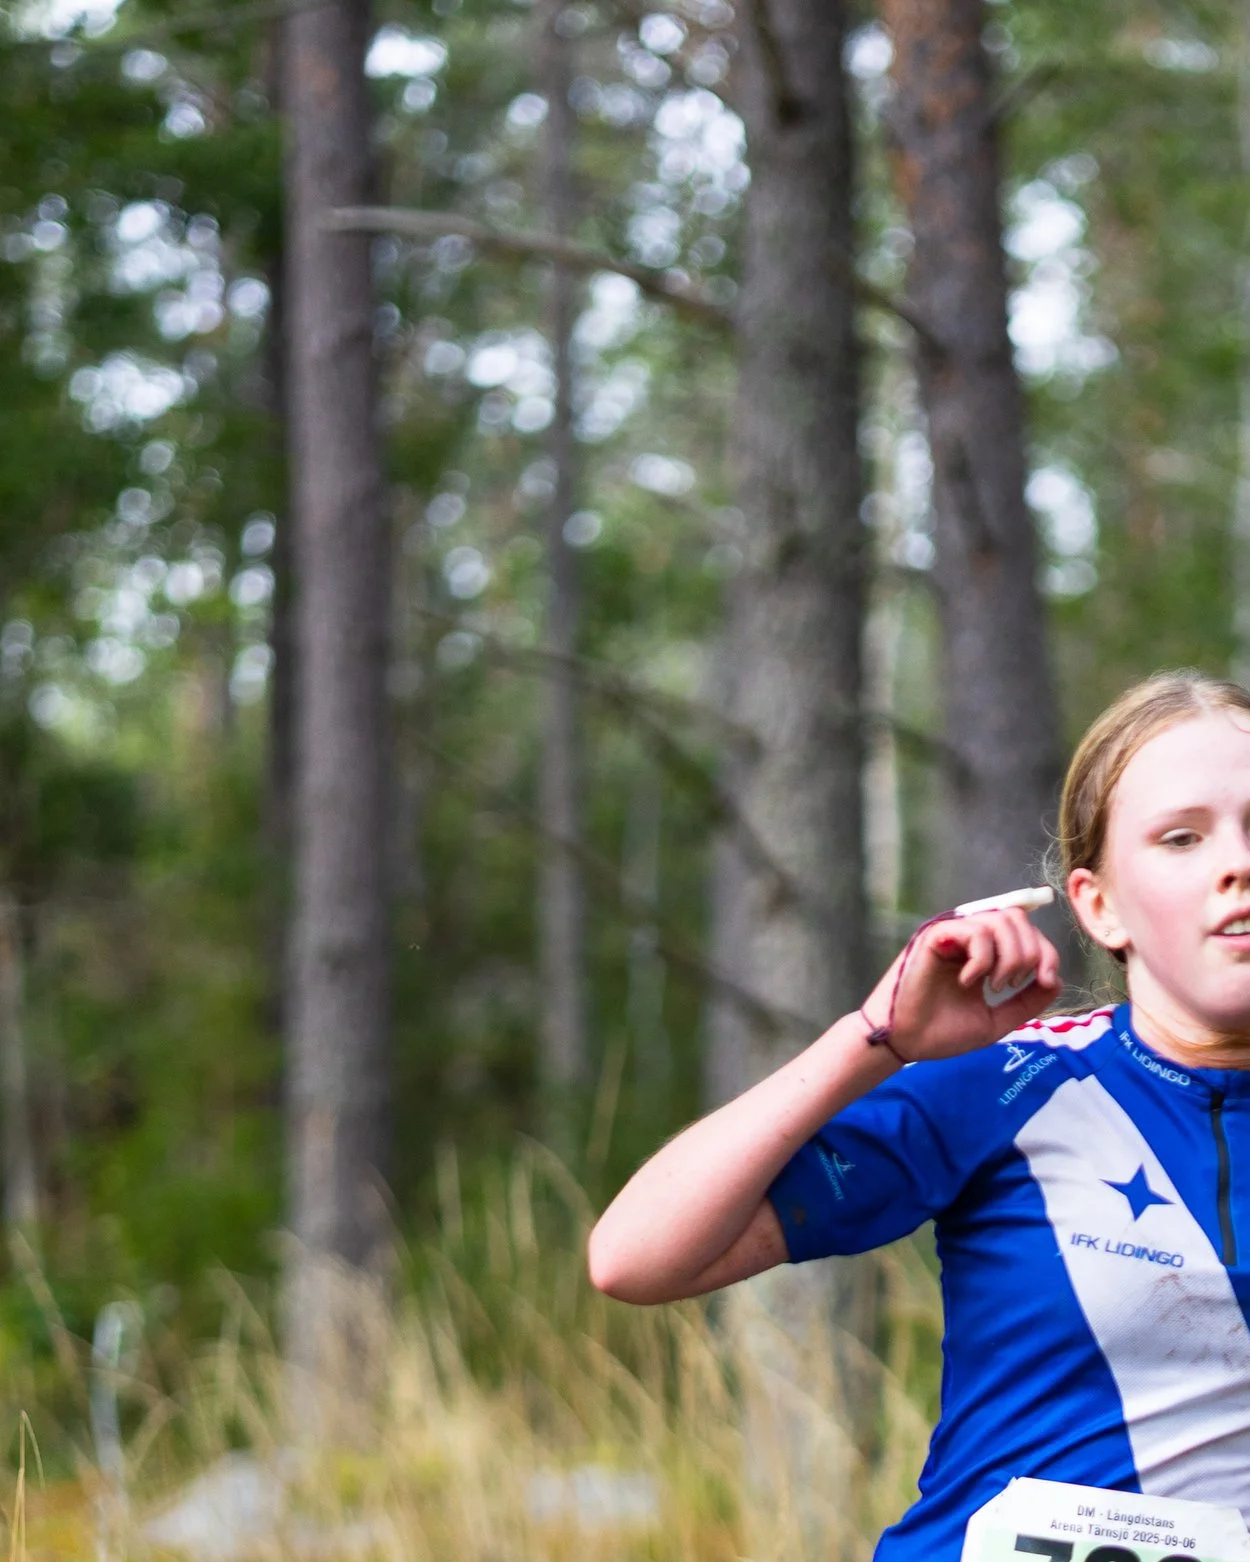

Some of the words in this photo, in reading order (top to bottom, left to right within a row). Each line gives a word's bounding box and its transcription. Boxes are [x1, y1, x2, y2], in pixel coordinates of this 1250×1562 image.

[1070, 1231, 1101, 1251] IFK
[1077, 1505, 1096, 1518] DM
[1107, 1509, 1175, 1529] Långdistans
[1050, 1519, 1083, 1534] Arena
[1088, 1523, 1129, 1541] Tärnsjö
[1133, 1530, 1197, 1549] 2025-09-06
